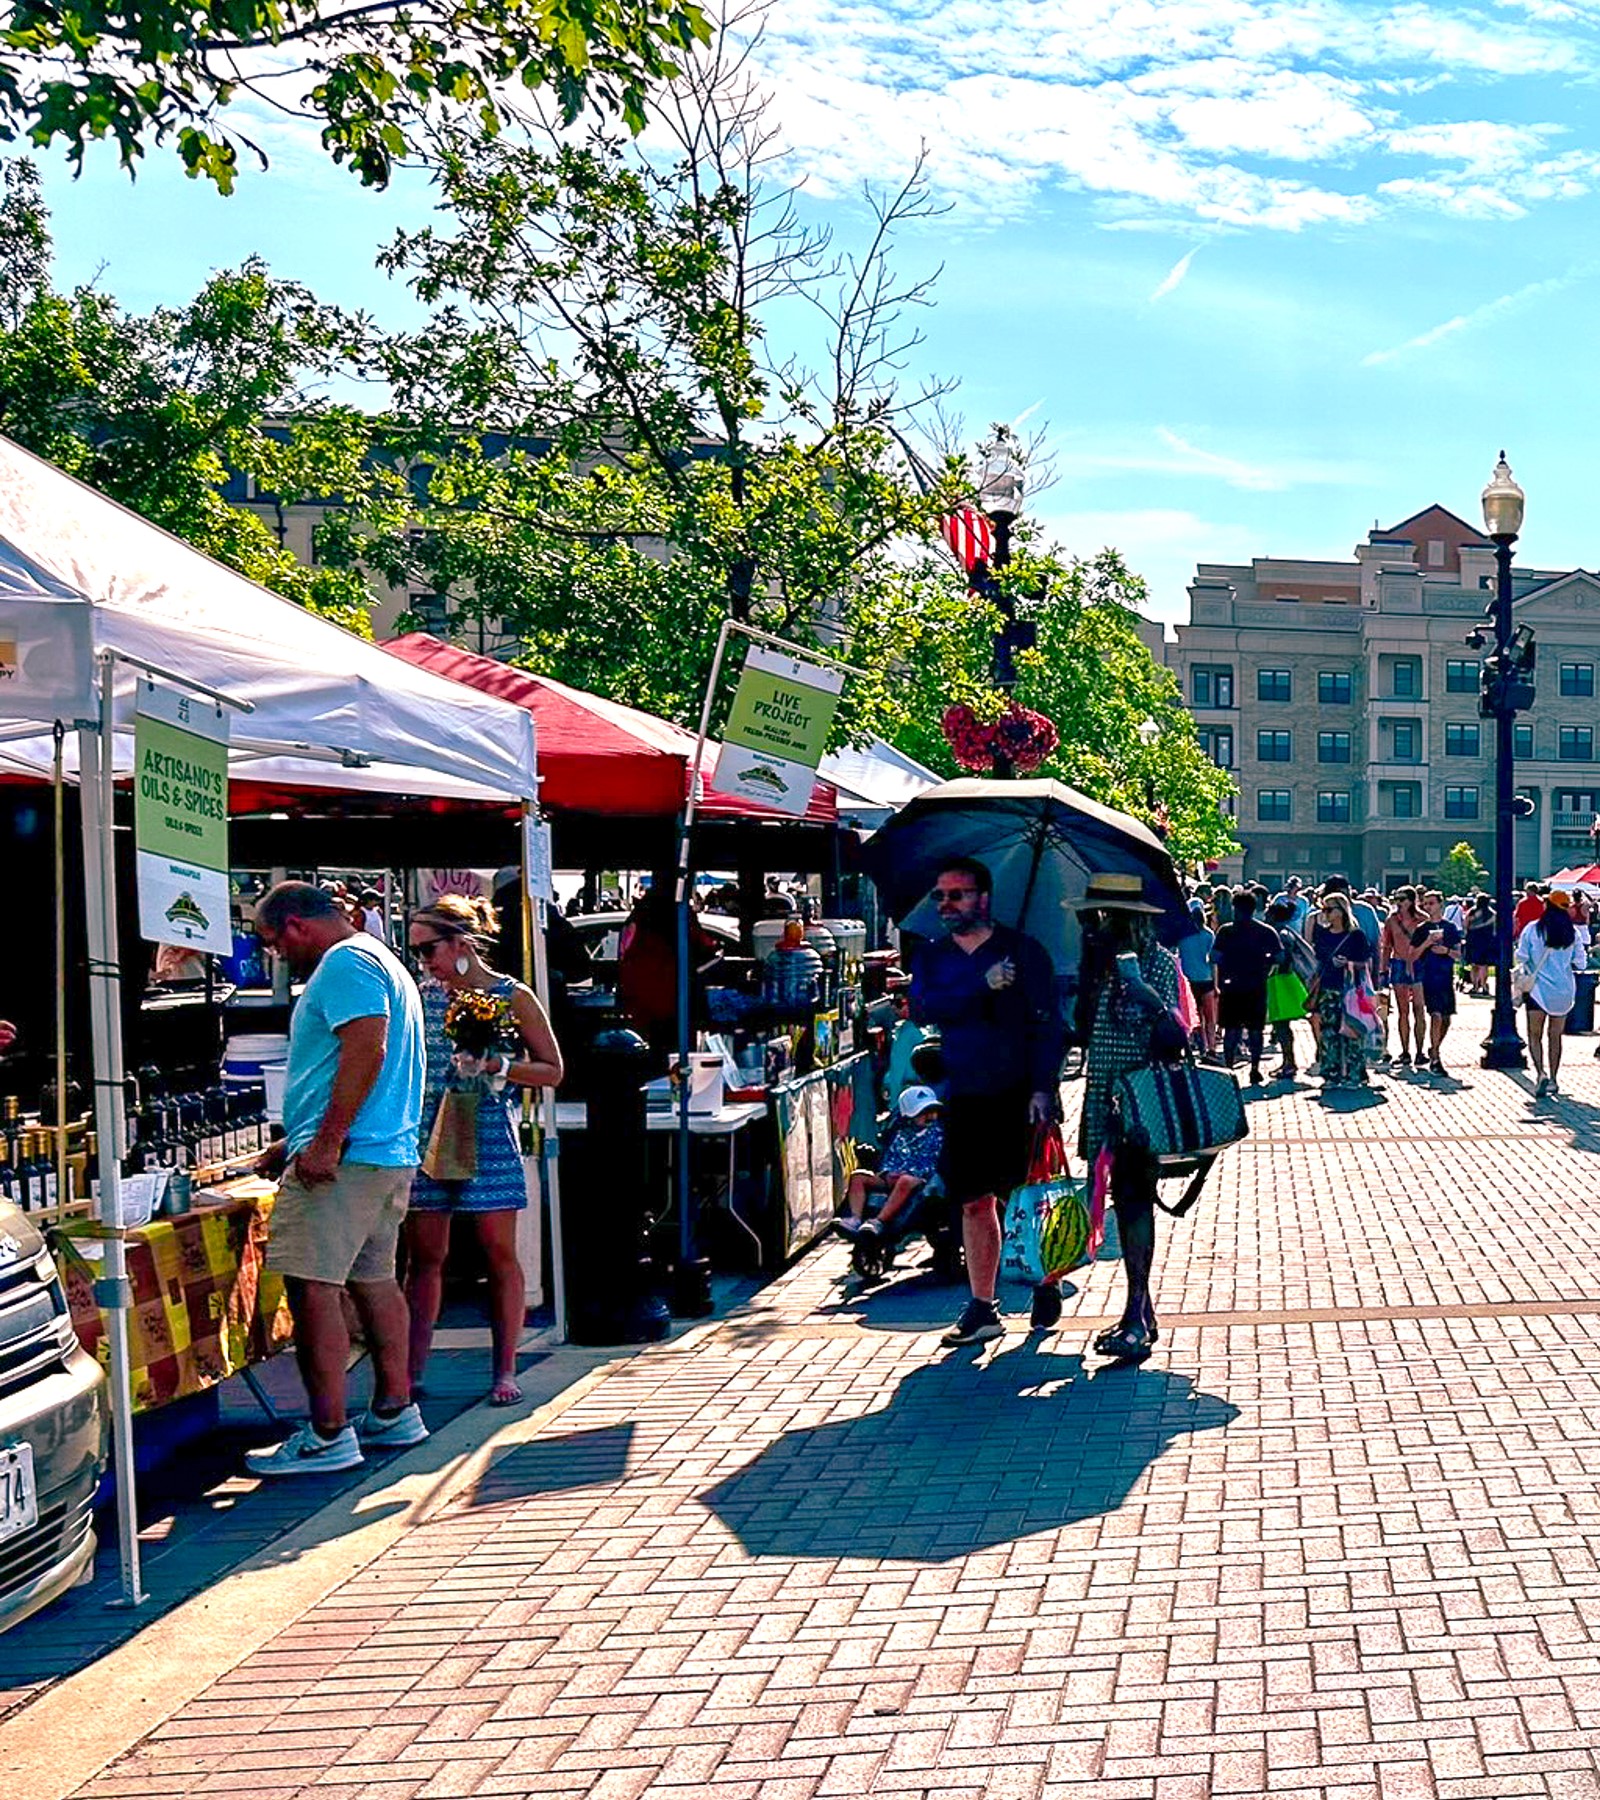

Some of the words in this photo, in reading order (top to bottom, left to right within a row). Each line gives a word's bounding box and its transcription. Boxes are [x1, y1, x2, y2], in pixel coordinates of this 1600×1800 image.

[753, 700, 811, 730] PROJECT
[772, 690, 803, 710] LIVE
[143, 749, 222, 795] ARTISANO'S
[141, 775, 170, 805] OILS
[172, 786, 182, 807] &
[184, 786, 224, 822] SPICES
